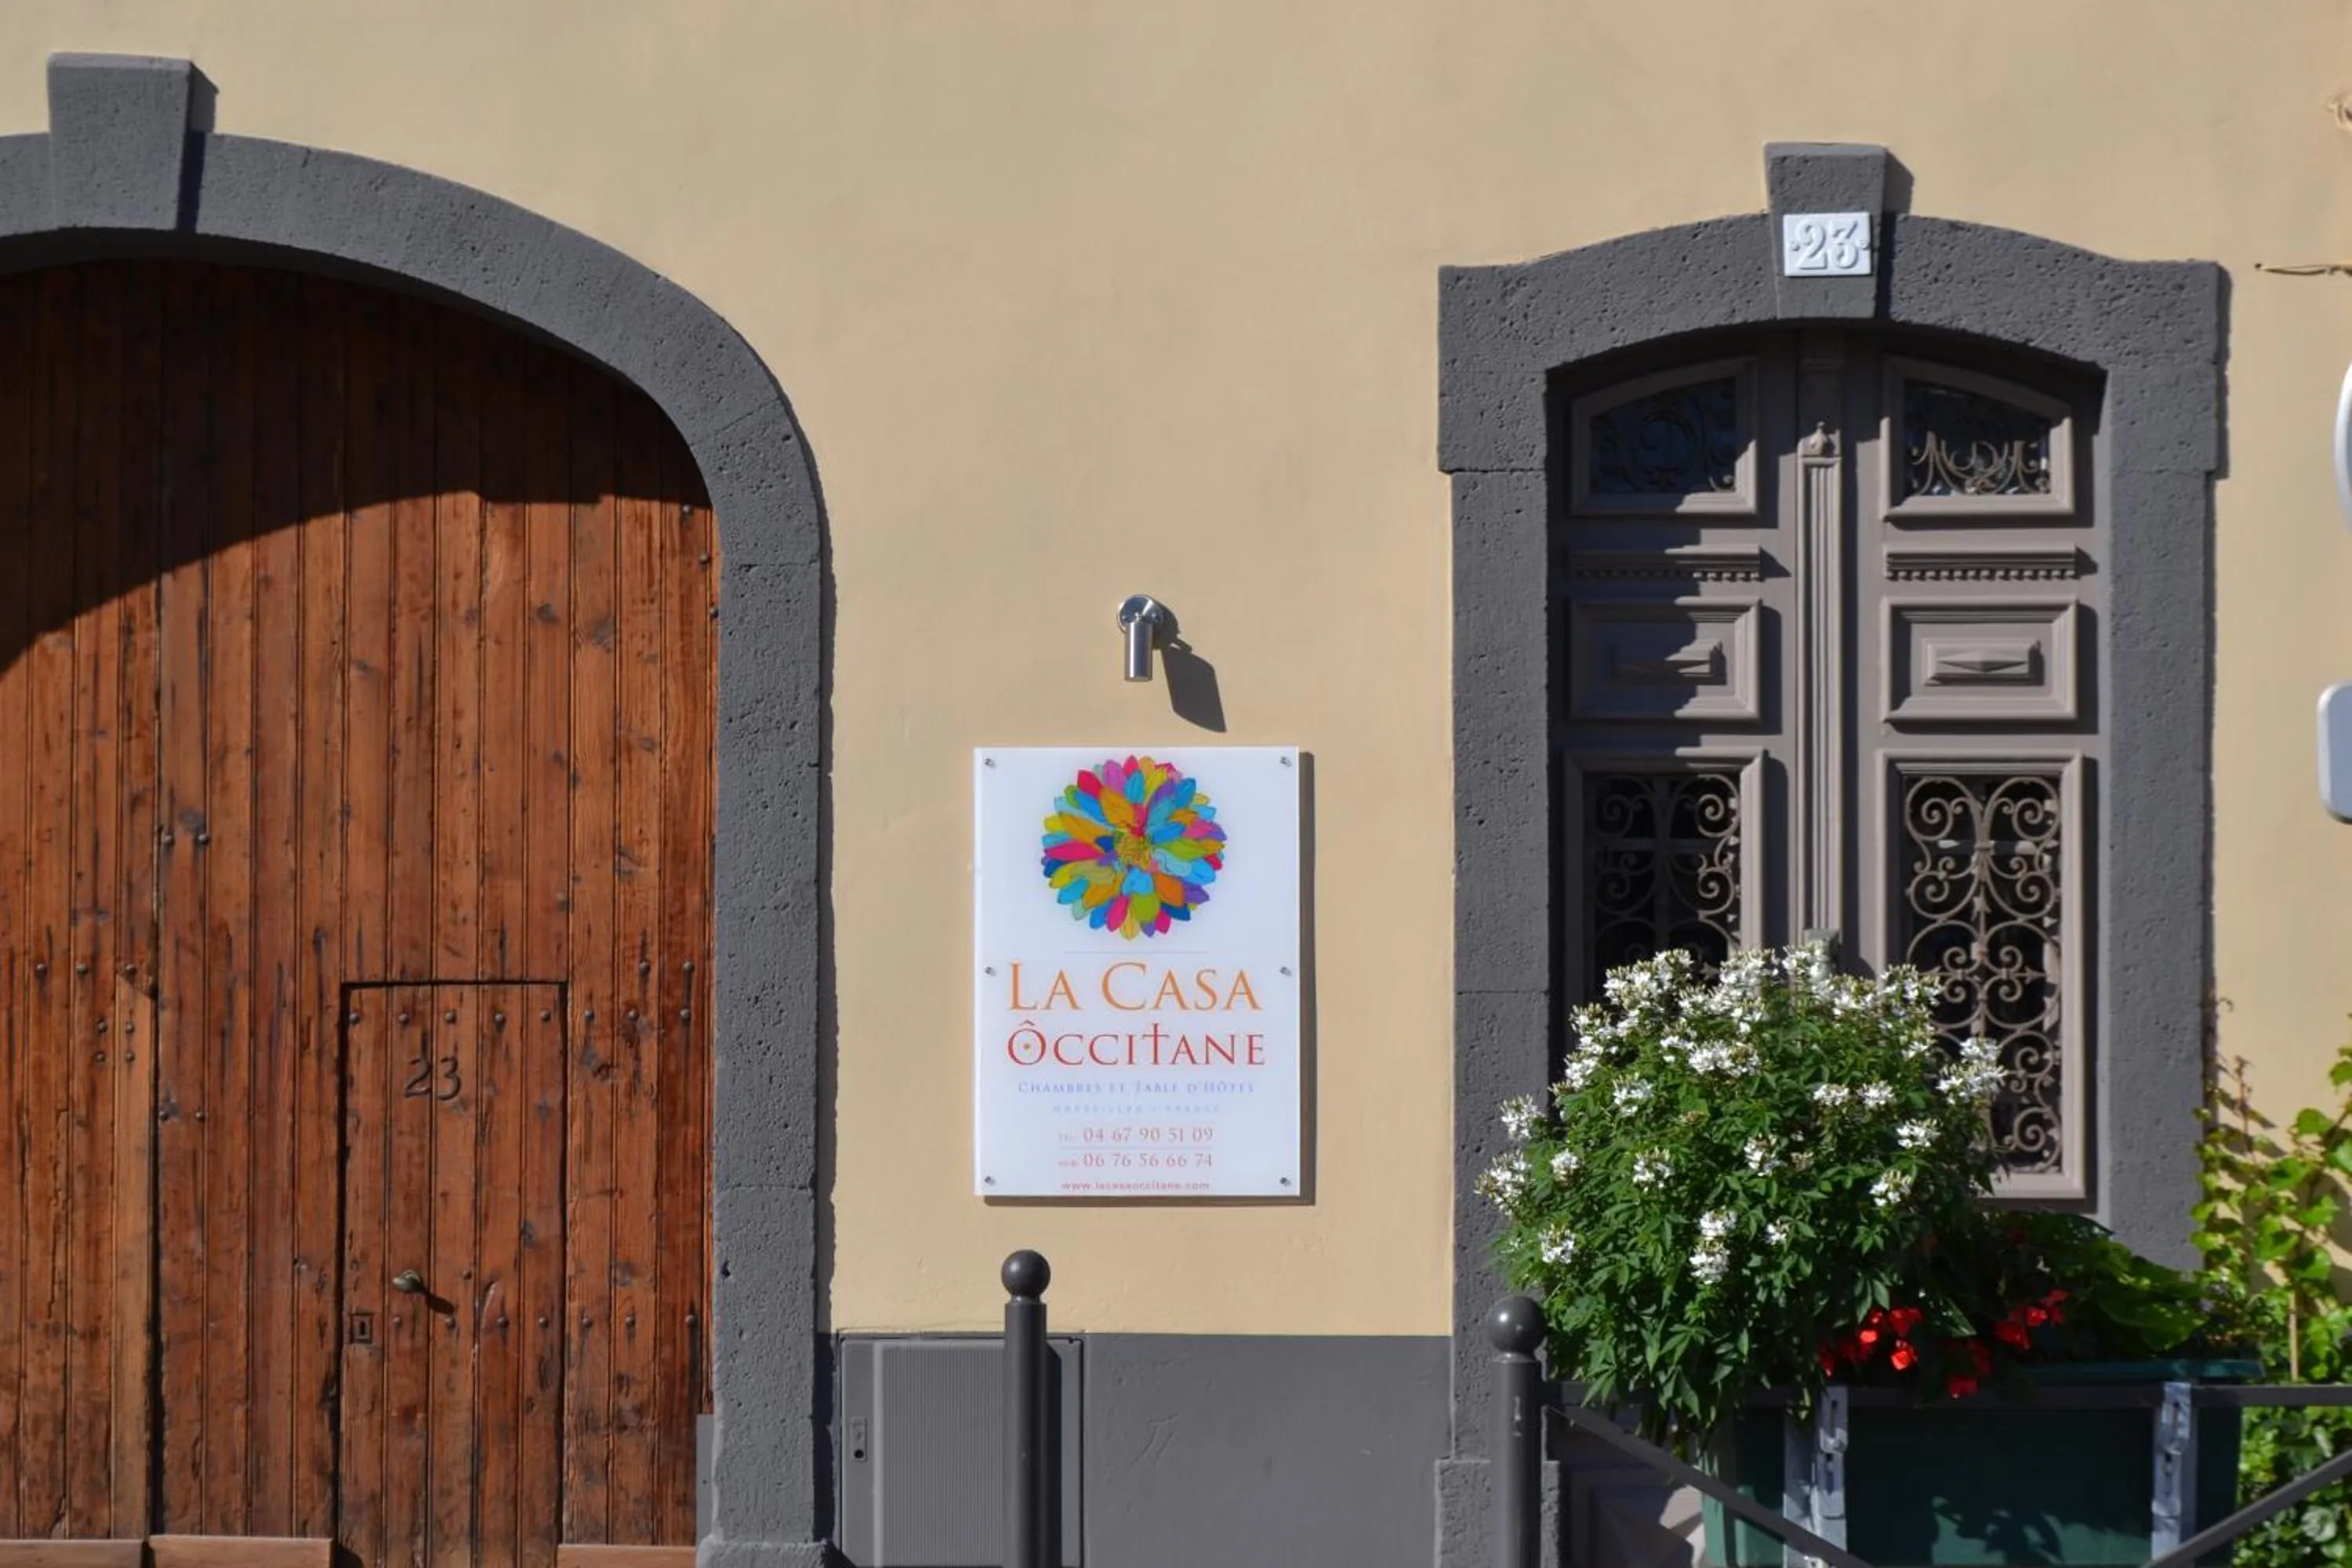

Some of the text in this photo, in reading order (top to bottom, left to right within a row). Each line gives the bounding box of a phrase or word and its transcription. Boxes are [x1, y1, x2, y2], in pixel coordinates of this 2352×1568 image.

[1796, 220, 1860, 270] 23
[1007, 961, 1264, 1011] LA CASA
[404, 1056, 463, 1102] 23
[1083, 1127, 1104, 1142] 04
[1112, 1127, 1133, 1142] 67
[1138, 1127, 1160, 1142] 90
[1167, 1127, 1184, 1142] 51
[1192, 1127, 1214, 1142] 09
[1083, 1152, 1105, 1167] 06
[1112, 1152, 1131, 1167] 76
[1138, 1152, 1160, 1167] 56
[1165, 1152, 1188, 1167] 66
[1193, 1152, 1213, 1167] 74
